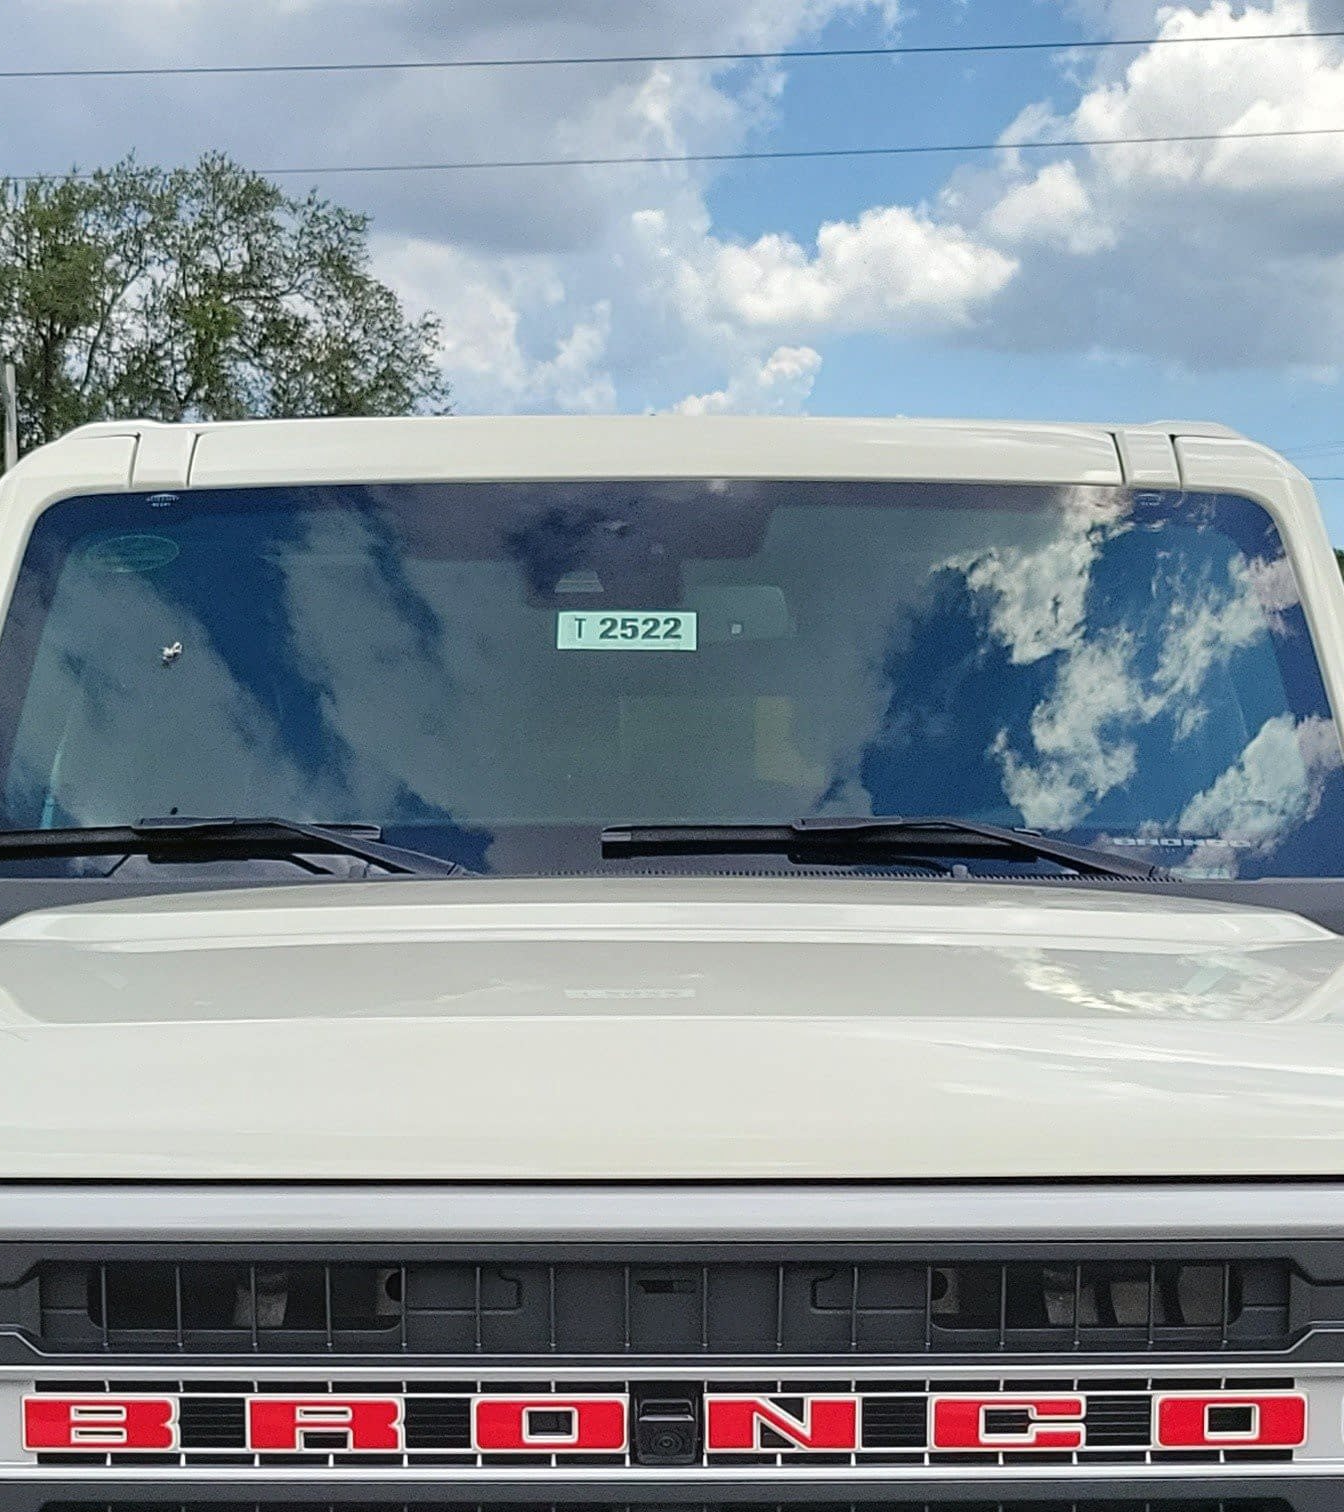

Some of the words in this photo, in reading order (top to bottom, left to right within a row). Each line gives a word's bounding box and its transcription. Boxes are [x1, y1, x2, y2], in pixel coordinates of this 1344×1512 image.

[574, 617, 587, 639] T
[598, 617, 682, 640] 2522
[22, 1393, 1308, 1453] BRONCO
